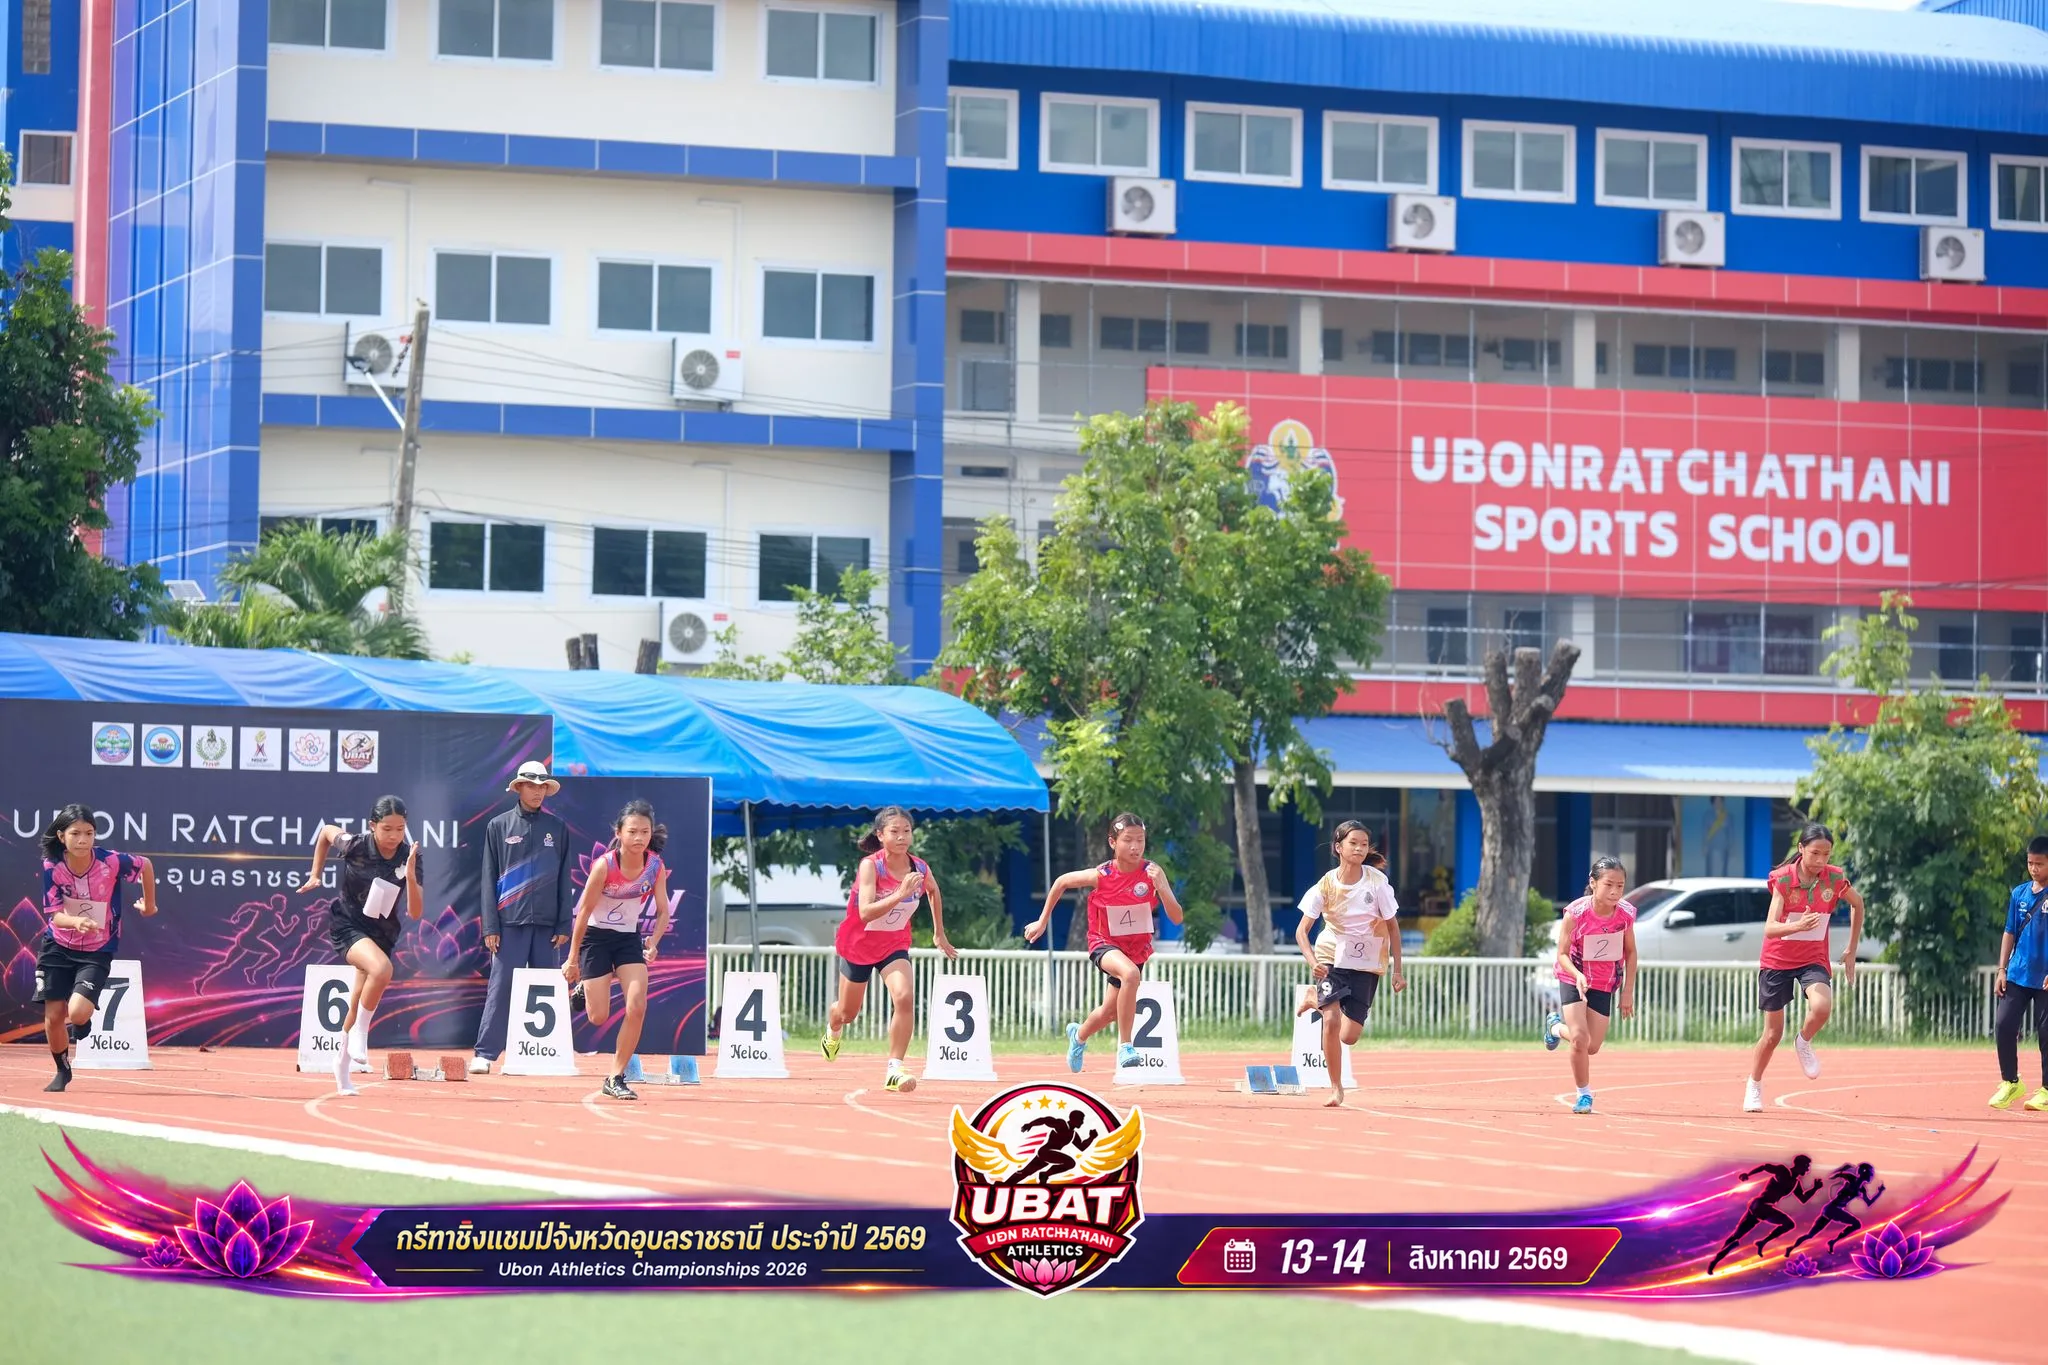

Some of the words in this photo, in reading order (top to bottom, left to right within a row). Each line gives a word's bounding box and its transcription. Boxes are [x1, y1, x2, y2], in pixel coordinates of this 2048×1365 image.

[1411, 436, 1950, 506] UBONRATCHATHANI
[1474, 504, 1679, 557] SPORTS
[1708, 513, 1909, 567] SCHOOL
[14, 808, 147, 841] UON
[607, 902, 624, 921] 6
[885, 908, 905, 925] 5
[1119, 909, 1137, 927] 4
[1349, 942, 1365, 958] 3
[1593, 939, 1609, 959] 2
[101, 977, 130, 1031] 7
[317, 979, 350, 1032] 6
[523, 984, 556, 1038] 5
[735, 989, 767, 1041] 4
[944, 990, 975, 1043] 3
[1133, 998, 1163, 1048] 2
[90, 1034, 130, 1050] Nelco
[312, 1035, 342, 1051] Nelc
[518, 1041, 557, 1057] Nelco
[730, 1044, 768, 1060] Nelco
[1138, 1053, 1164, 1068] elco
